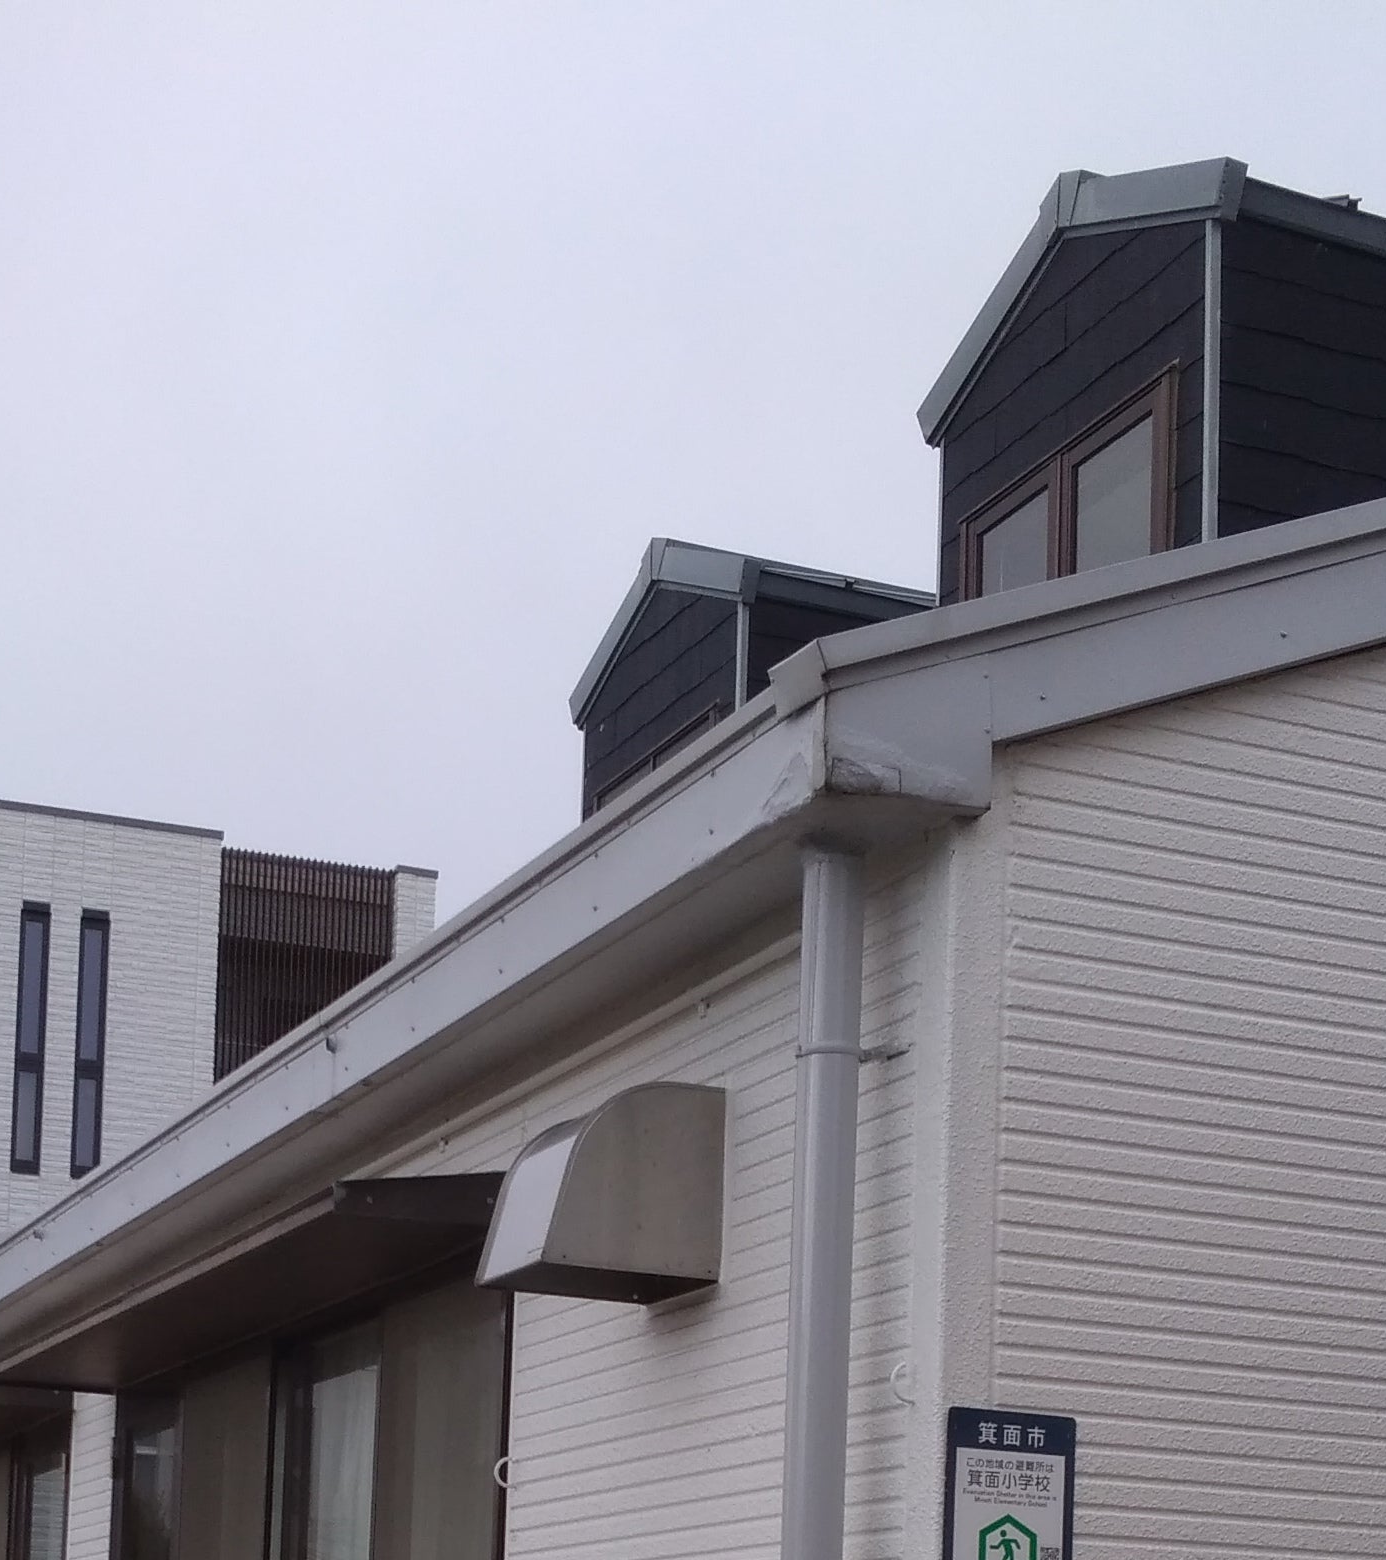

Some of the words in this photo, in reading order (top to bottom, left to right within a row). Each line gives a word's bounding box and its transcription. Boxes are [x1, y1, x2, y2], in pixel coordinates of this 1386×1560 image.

[978, 1421, 1046, 1449] 箕面市
[966, 1457, 1054, 1473] この地域の避難所は
[967, 1469, 1051, 1492] 箕面小学校
